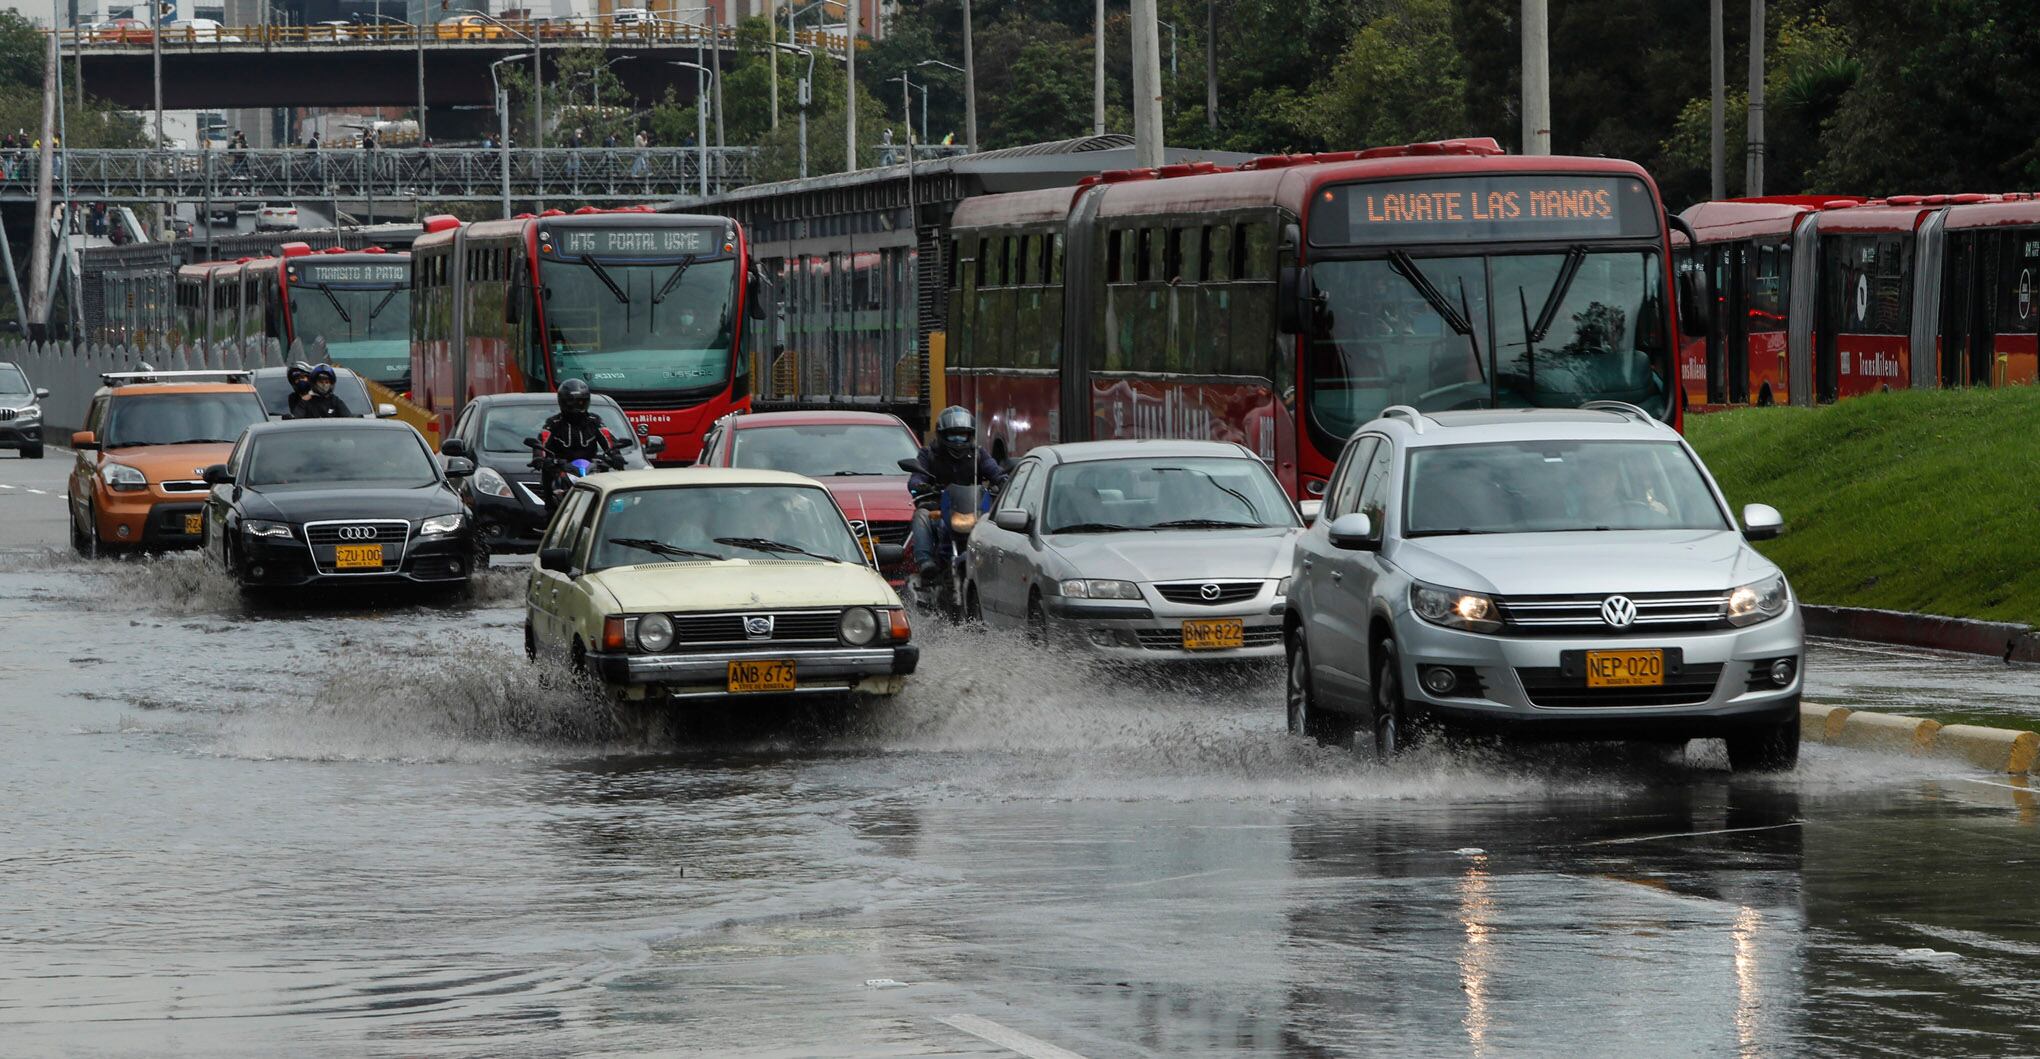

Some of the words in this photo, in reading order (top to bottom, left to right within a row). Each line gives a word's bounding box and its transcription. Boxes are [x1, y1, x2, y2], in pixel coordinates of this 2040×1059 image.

[1367, 193, 1464, 222] LAVATE
[1471, 191, 1521, 220] LAS
[1529, 189, 1613, 219] MANOS
[608, 233, 657, 250] PORTAL
[664, 232, 700, 249] USME
[315, 267, 360, 280] TRANSITO
[364, 267, 372, 280] A
[376, 266, 403, 280] PATIO
[1859, 351, 1899, 377] TransMilenio
